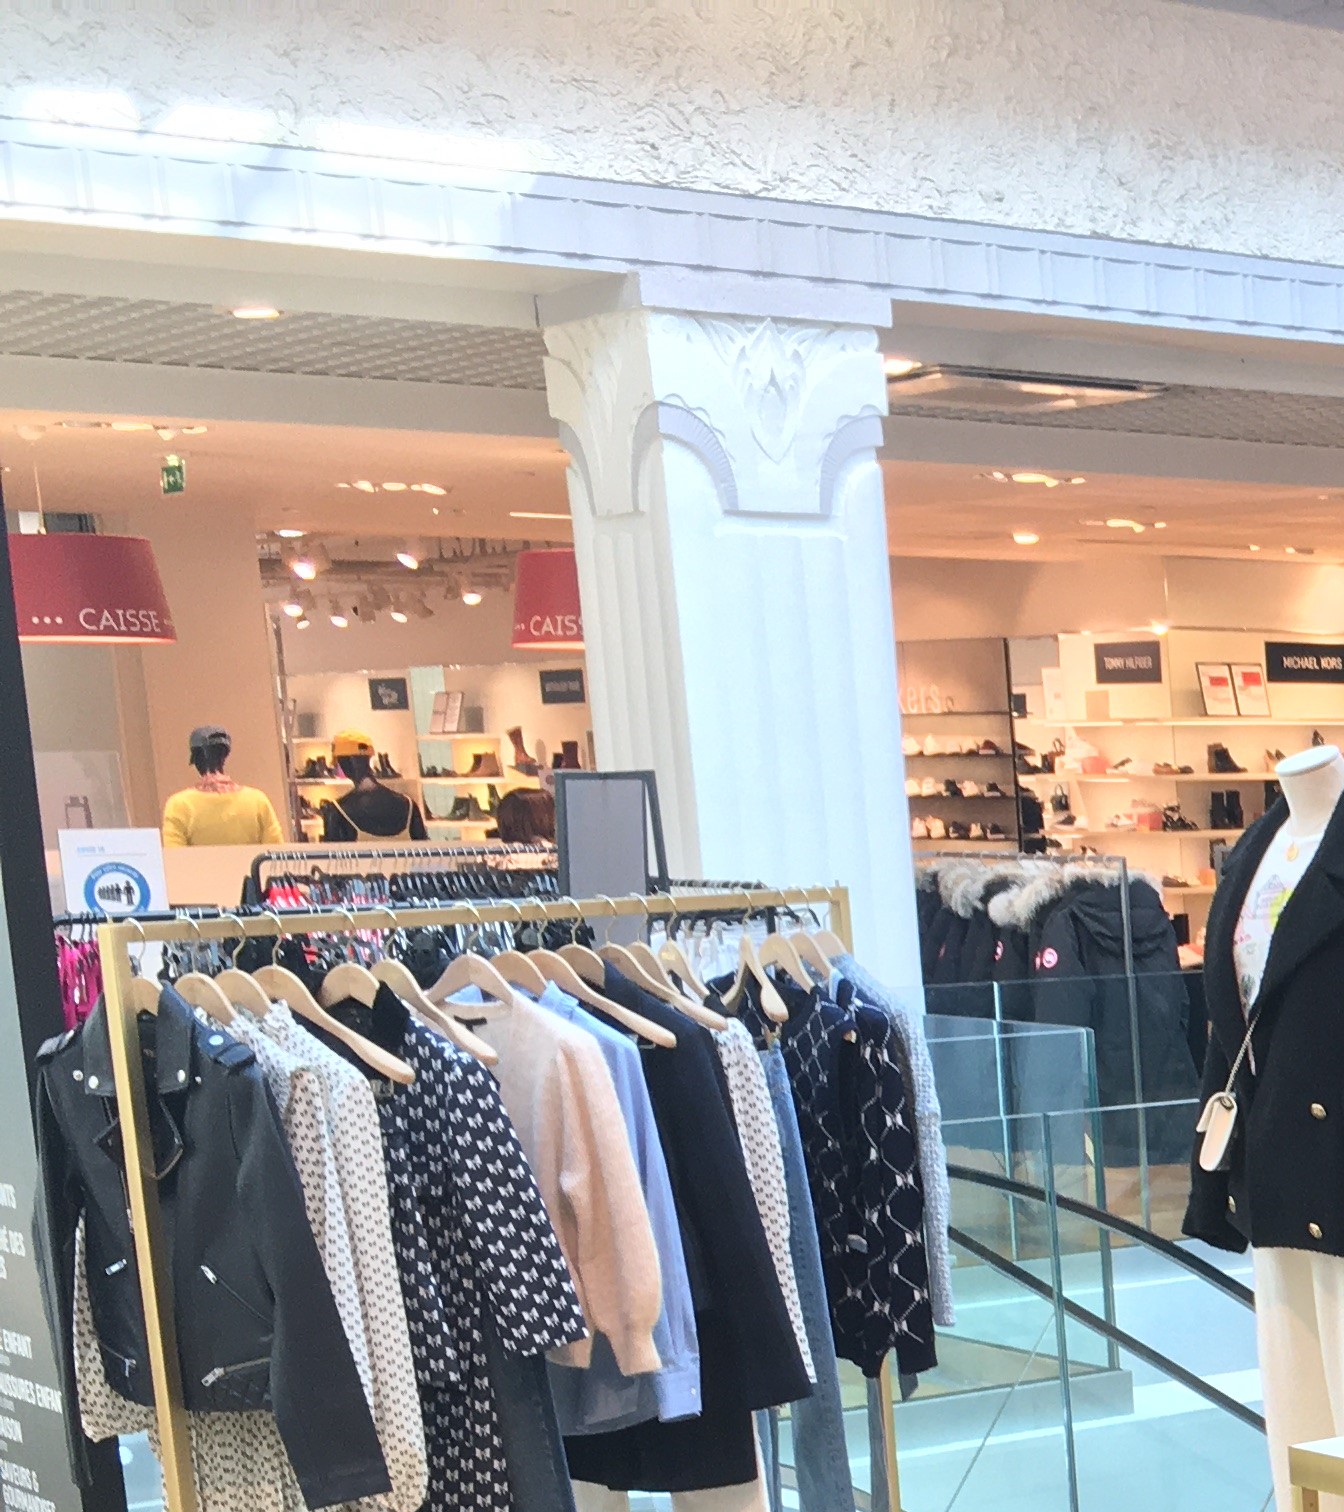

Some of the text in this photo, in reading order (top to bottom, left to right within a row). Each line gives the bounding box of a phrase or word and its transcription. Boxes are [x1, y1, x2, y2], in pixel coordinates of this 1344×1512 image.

[78, 608, 161, 632] CAISSE
[1282, 656, 1343, 670] MICHAEL KORS
